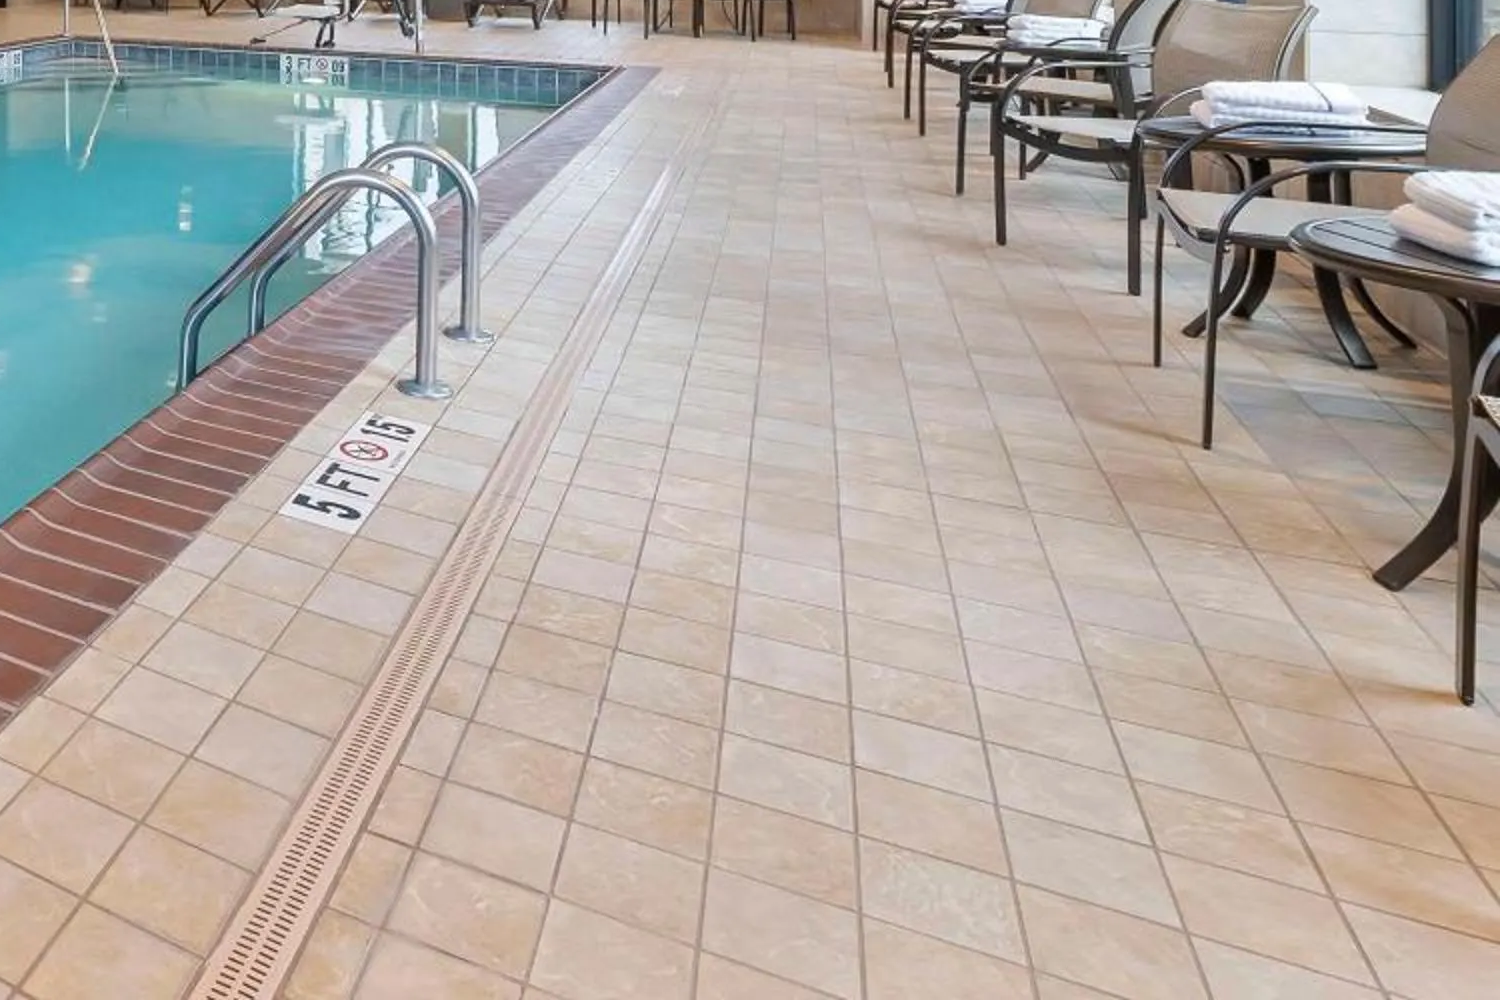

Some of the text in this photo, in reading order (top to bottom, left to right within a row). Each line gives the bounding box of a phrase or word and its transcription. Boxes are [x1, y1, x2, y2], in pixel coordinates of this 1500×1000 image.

[297, 58, 311, 71] FT
[316, 462, 381, 497] FT
[292, 493, 362, 520] 5
